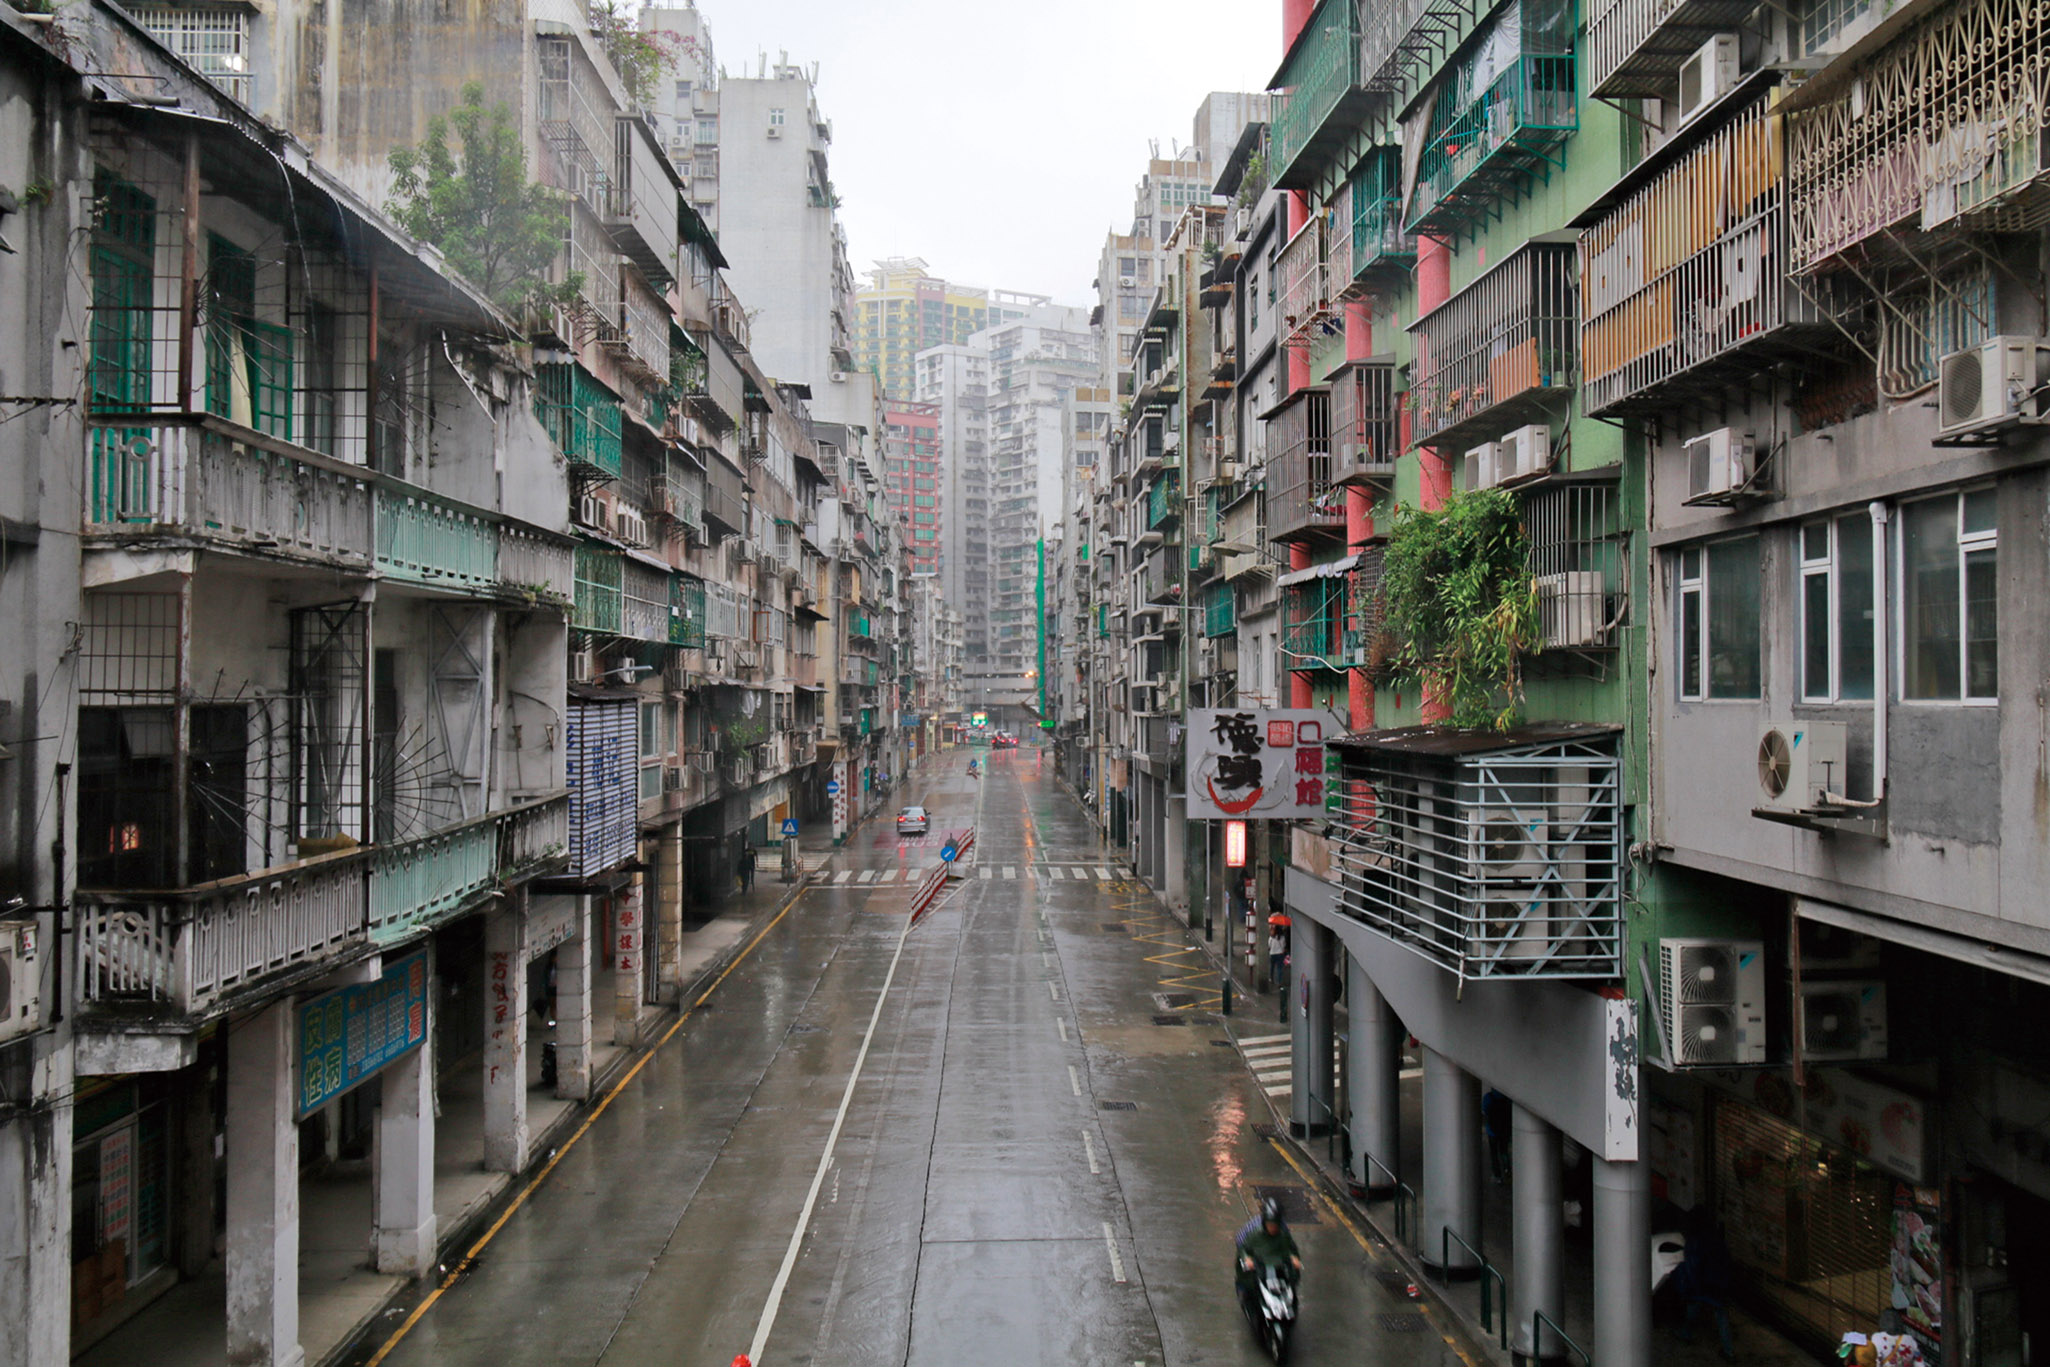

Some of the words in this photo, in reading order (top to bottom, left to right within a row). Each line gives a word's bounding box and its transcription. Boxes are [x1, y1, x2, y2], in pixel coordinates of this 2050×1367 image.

[1295, 720, 1323, 806] 口福館
[304, 1047, 343, 1107] 性病
